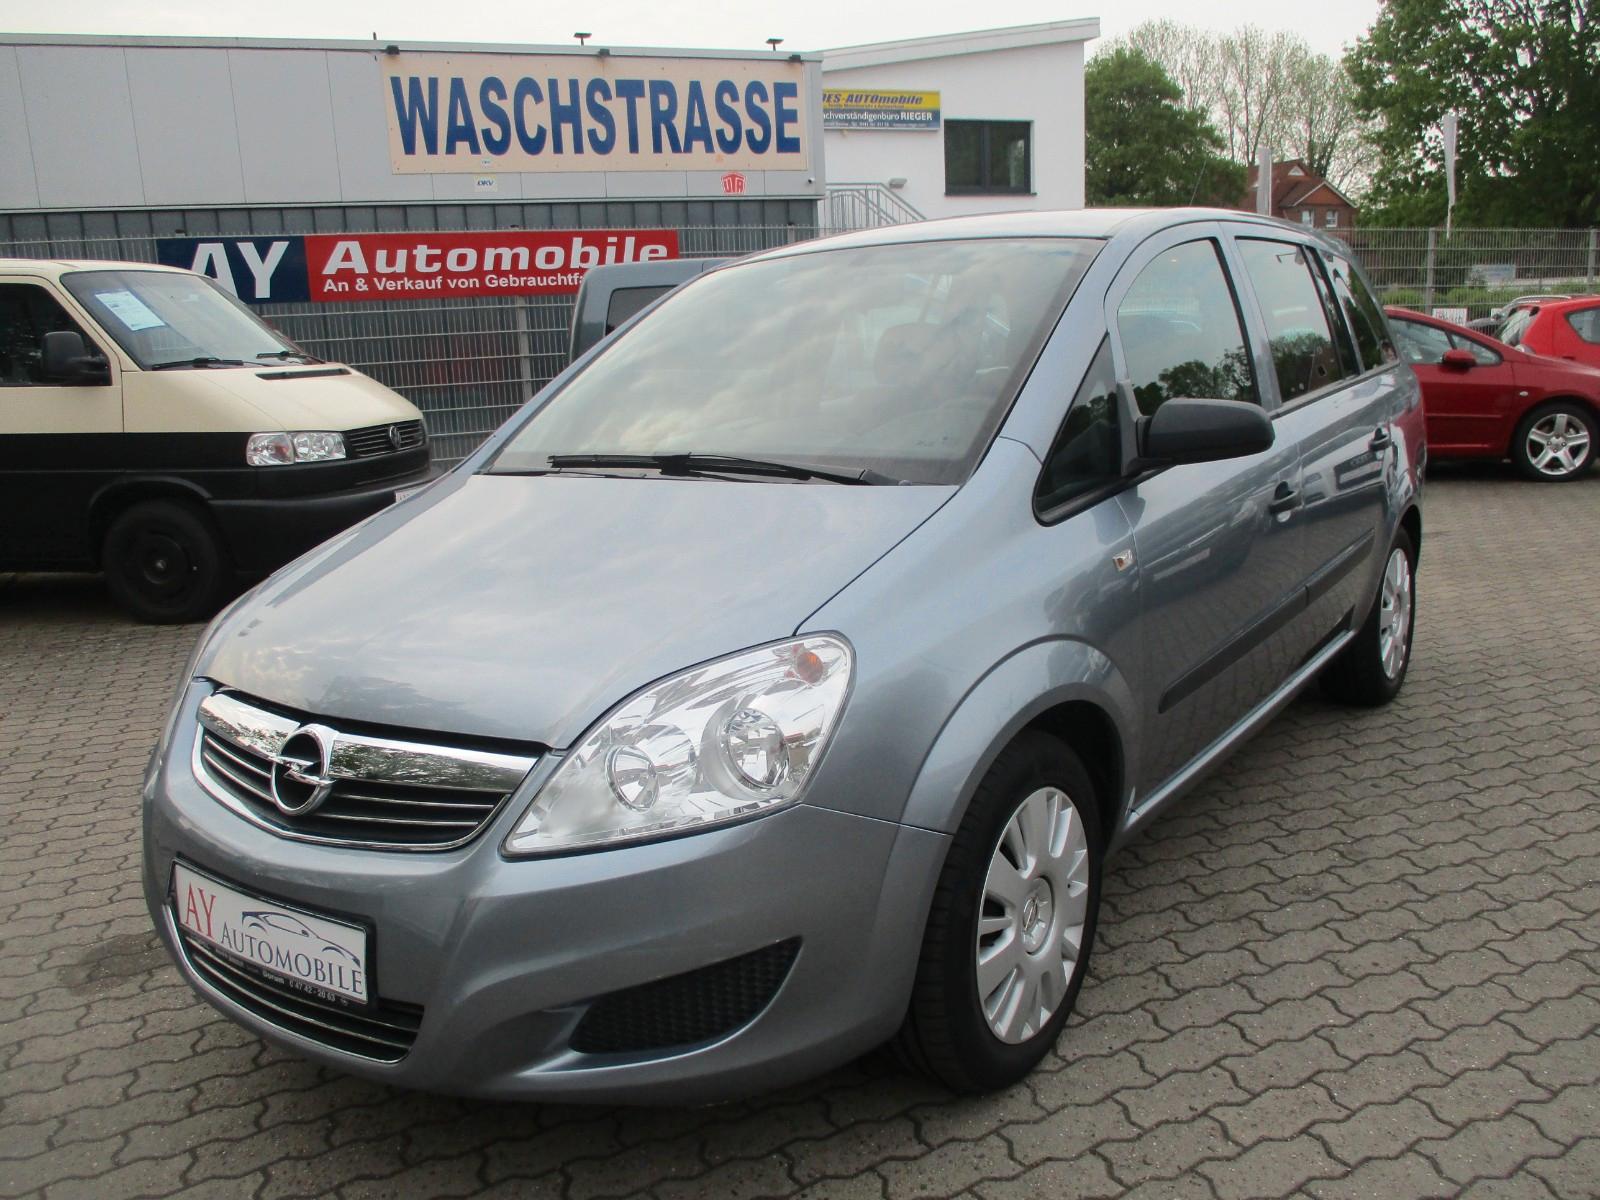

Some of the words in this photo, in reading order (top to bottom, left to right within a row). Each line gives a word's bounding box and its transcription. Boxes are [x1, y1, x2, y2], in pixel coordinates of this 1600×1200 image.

[390, 76, 800, 156] WASCHSTRASSE
[901, 112, 933, 121] RIEGER
[191, 241, 290, 299] AY
[322, 236, 667, 275] Automobile
[323, 278, 349, 292] An
[355, 277, 368, 291] &
[374, 275, 443, 290] Verkauf
[447, 278, 480, 288] von
[186, 880, 217, 939] AY
[221, 921, 364, 995] AUTOMOBILE
